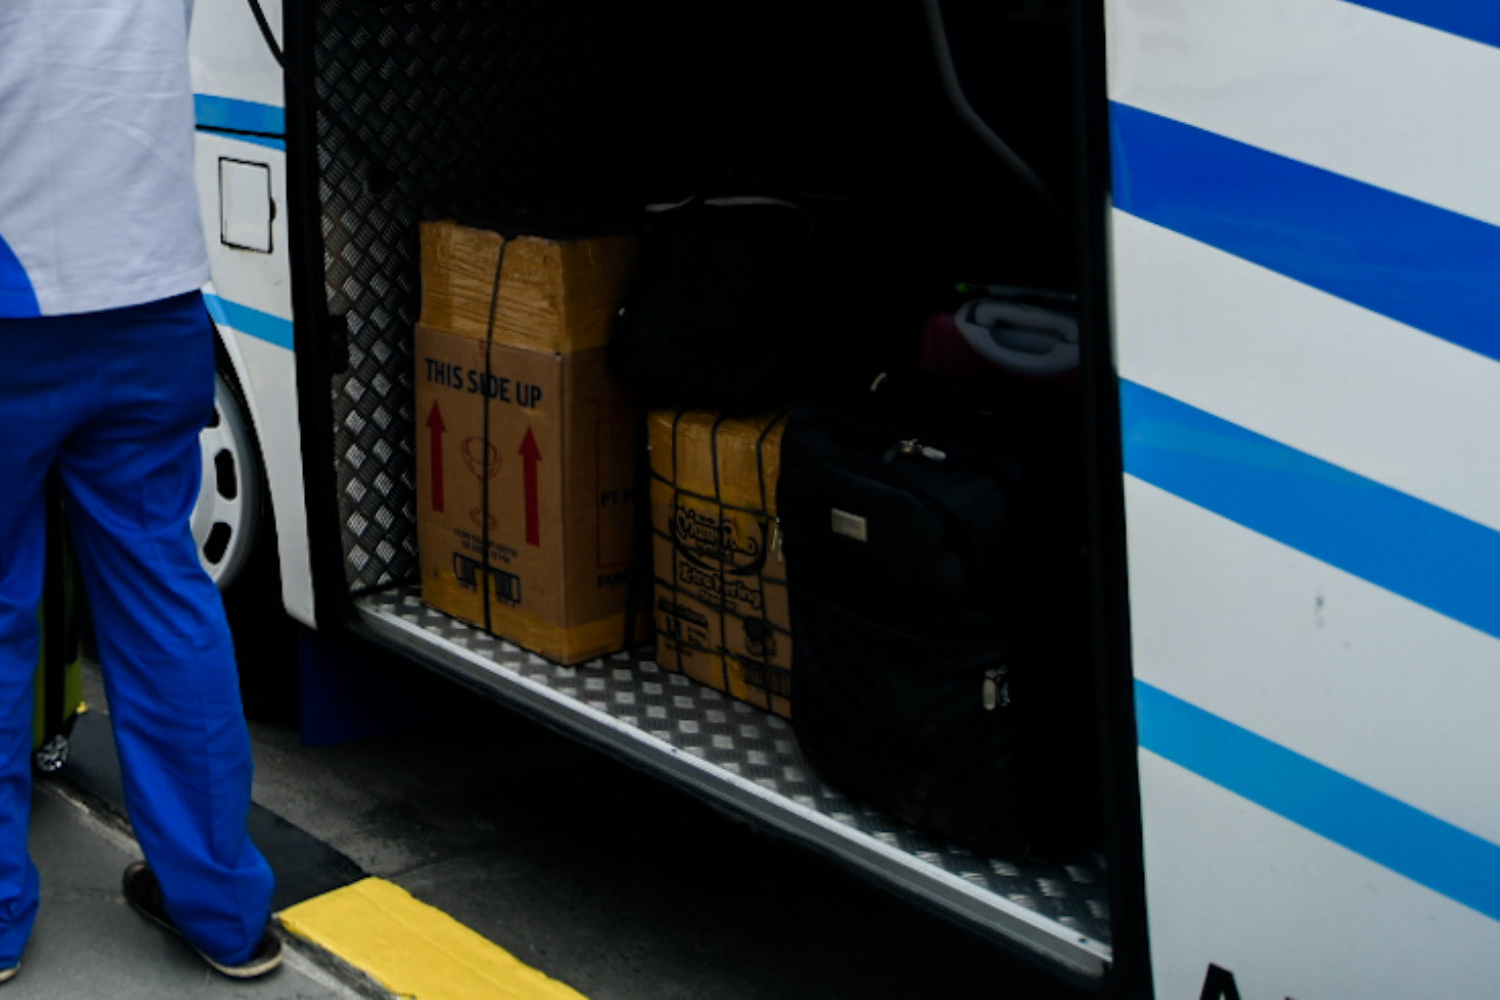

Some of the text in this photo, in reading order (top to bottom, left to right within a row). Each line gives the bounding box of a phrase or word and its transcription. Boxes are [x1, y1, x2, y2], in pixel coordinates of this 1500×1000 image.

[424, 358, 542, 409] THIS SIDE UP
